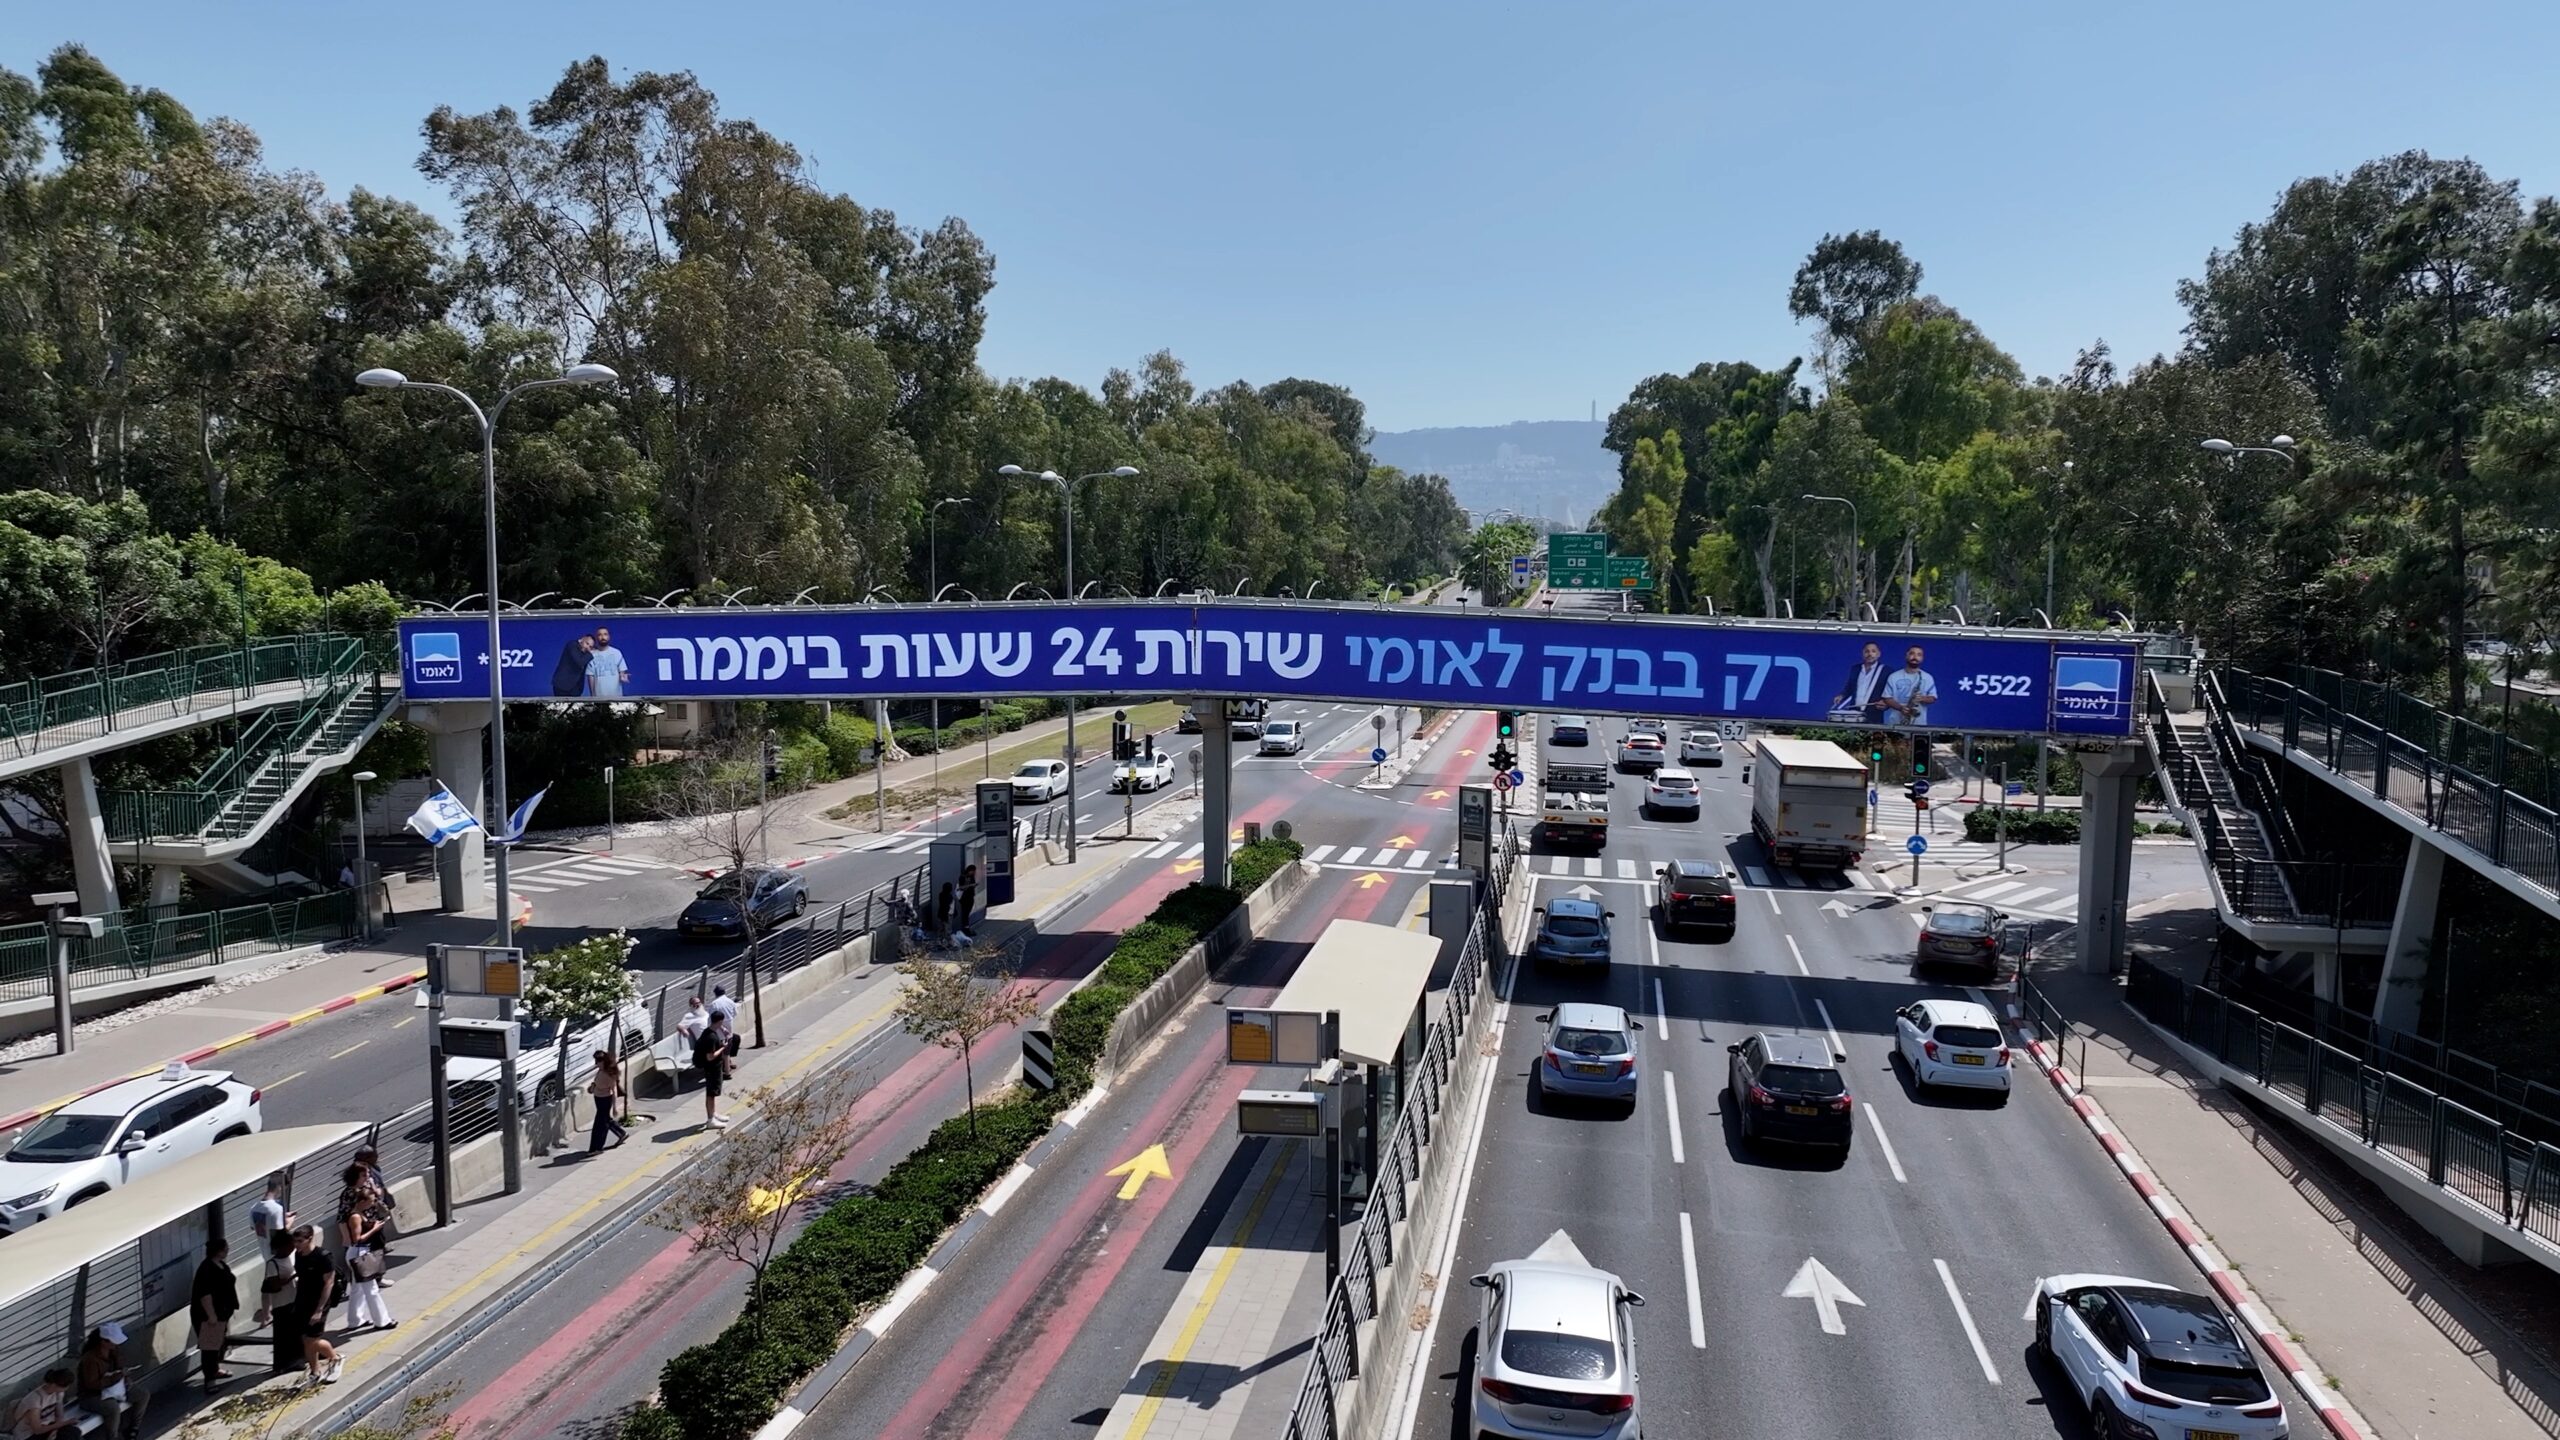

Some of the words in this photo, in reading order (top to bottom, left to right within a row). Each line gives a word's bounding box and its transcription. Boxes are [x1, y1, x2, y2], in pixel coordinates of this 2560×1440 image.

[420, 664, 455, 678] לאומי
[478, 648, 534, 669] 522
[657, 635, 849, 681] ביממה
[859, 632, 1033, 679] שעות
[1050, 626, 1123, 676] 24
[1135, 628, 1323, 680] שירות
[1346, 629, 1524, 689] לאומי
[1543, 646, 1704, 701] בבנק
[1724, 654, 1811, 710] רק
[2062, 695, 2110, 710] לאומי
[1225, 700, 1260, 717] MM
[1724, 725, 1744, 736] 5.7
